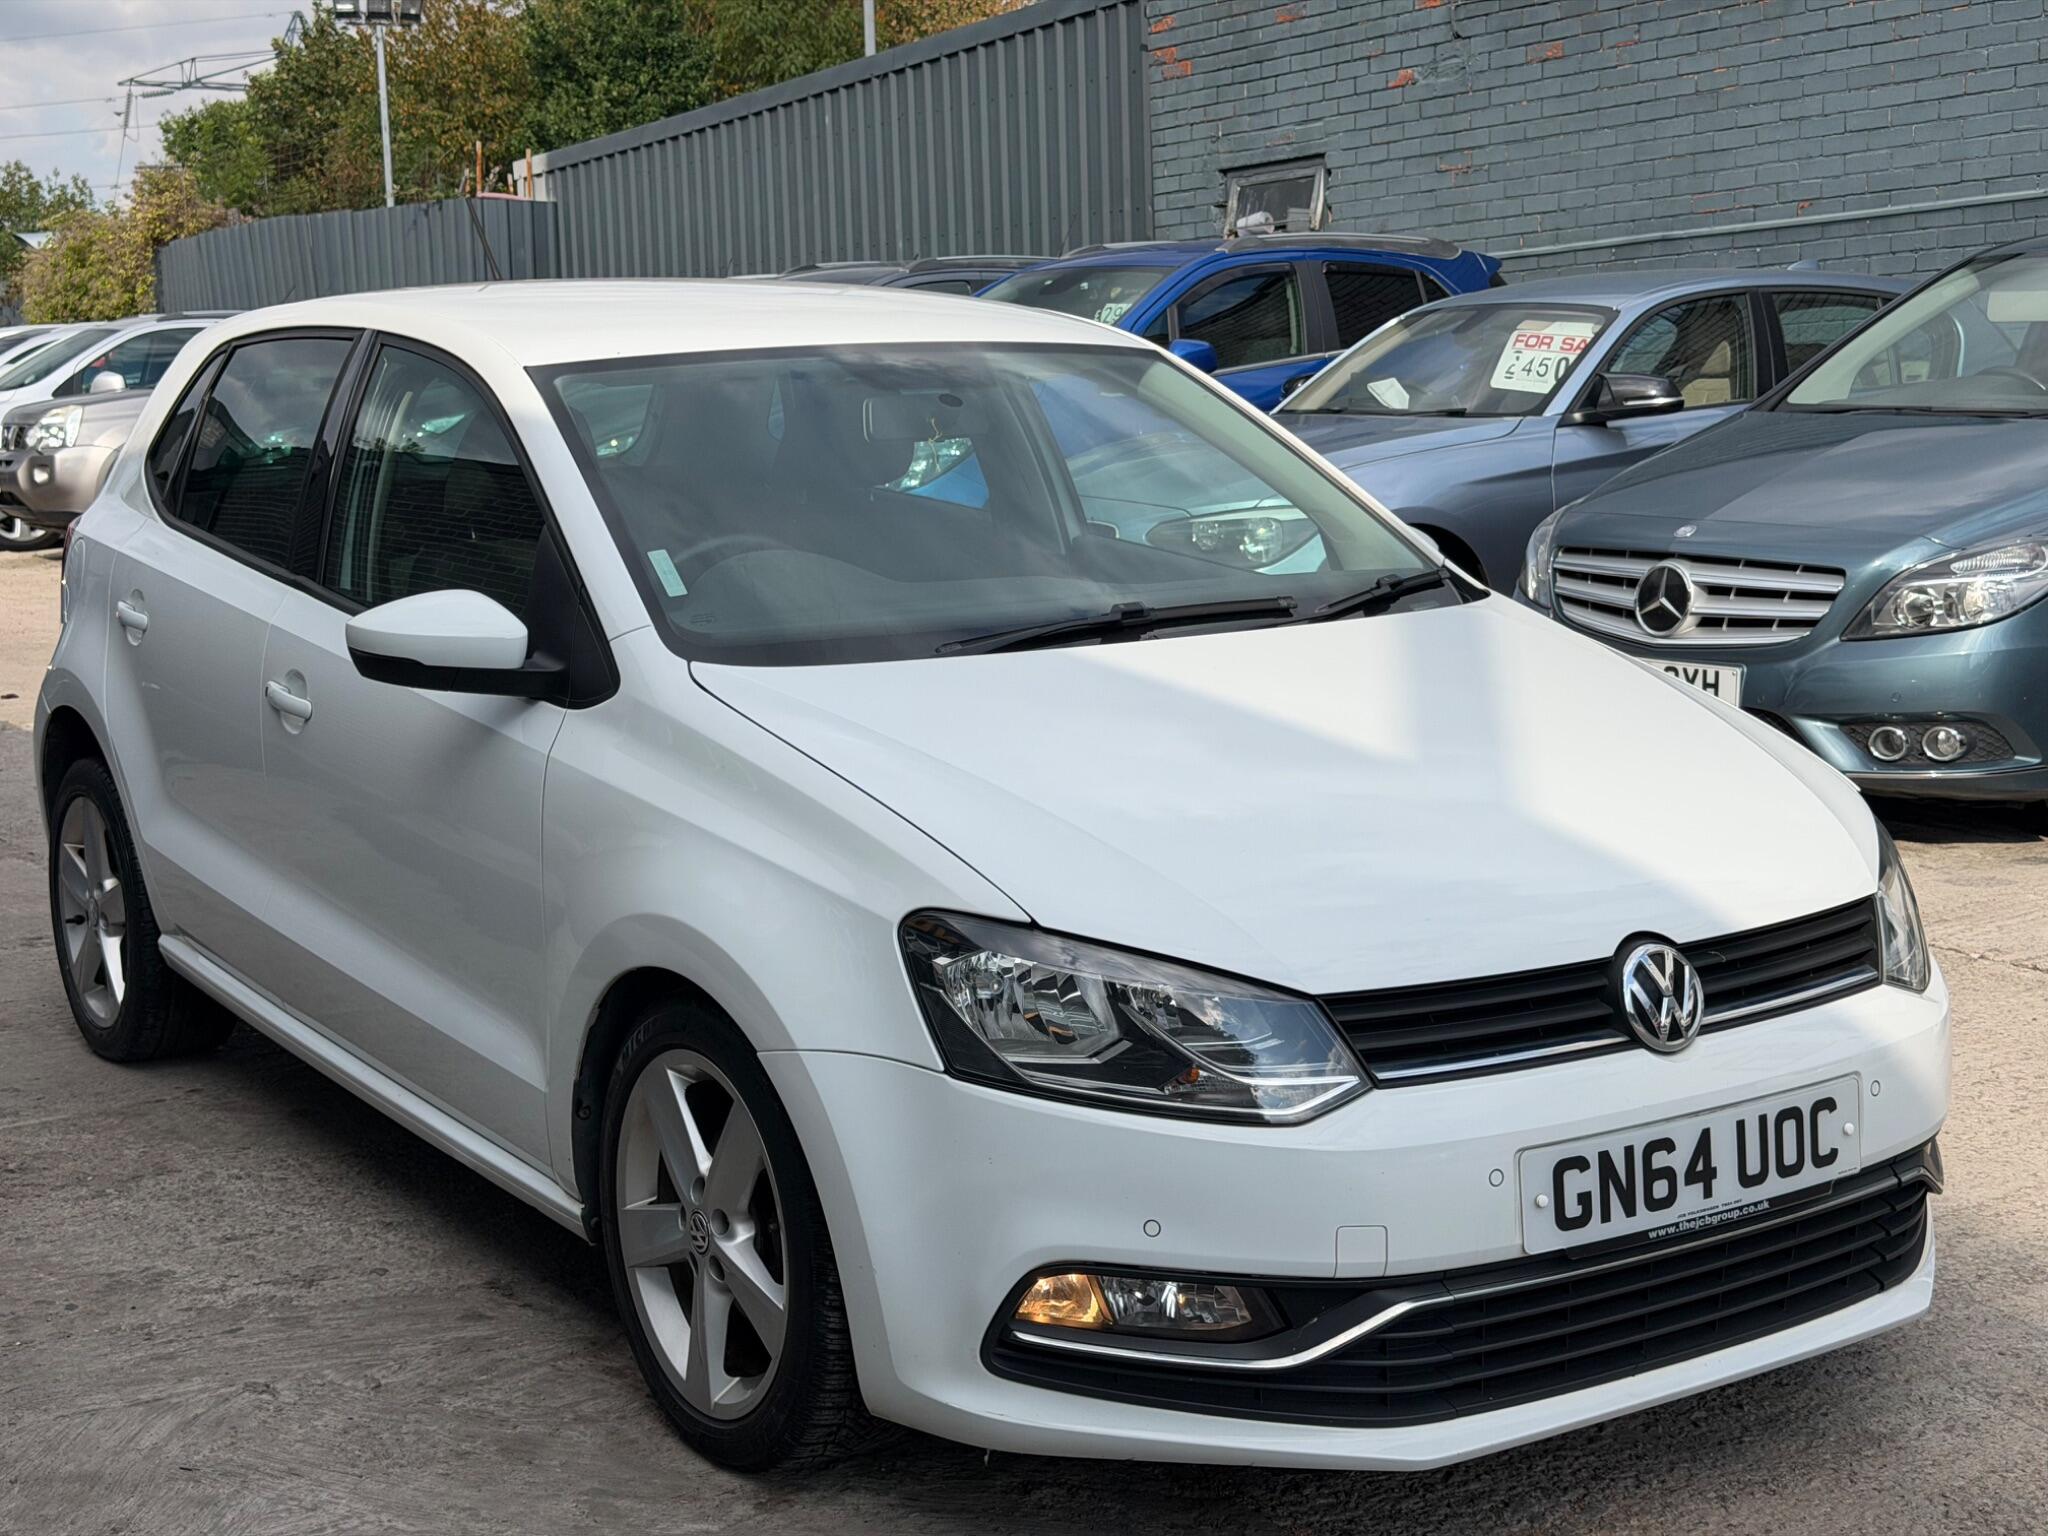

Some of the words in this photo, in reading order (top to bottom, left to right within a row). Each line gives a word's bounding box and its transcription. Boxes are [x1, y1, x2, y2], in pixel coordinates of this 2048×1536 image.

[1512, 333, 1554, 349] FOR
[1552, 1127, 1718, 1232] GN64
[1735, 1096, 1840, 1189] UOC
[1648, 1199, 1770, 1240] www.thejcbgroup.co.uk
